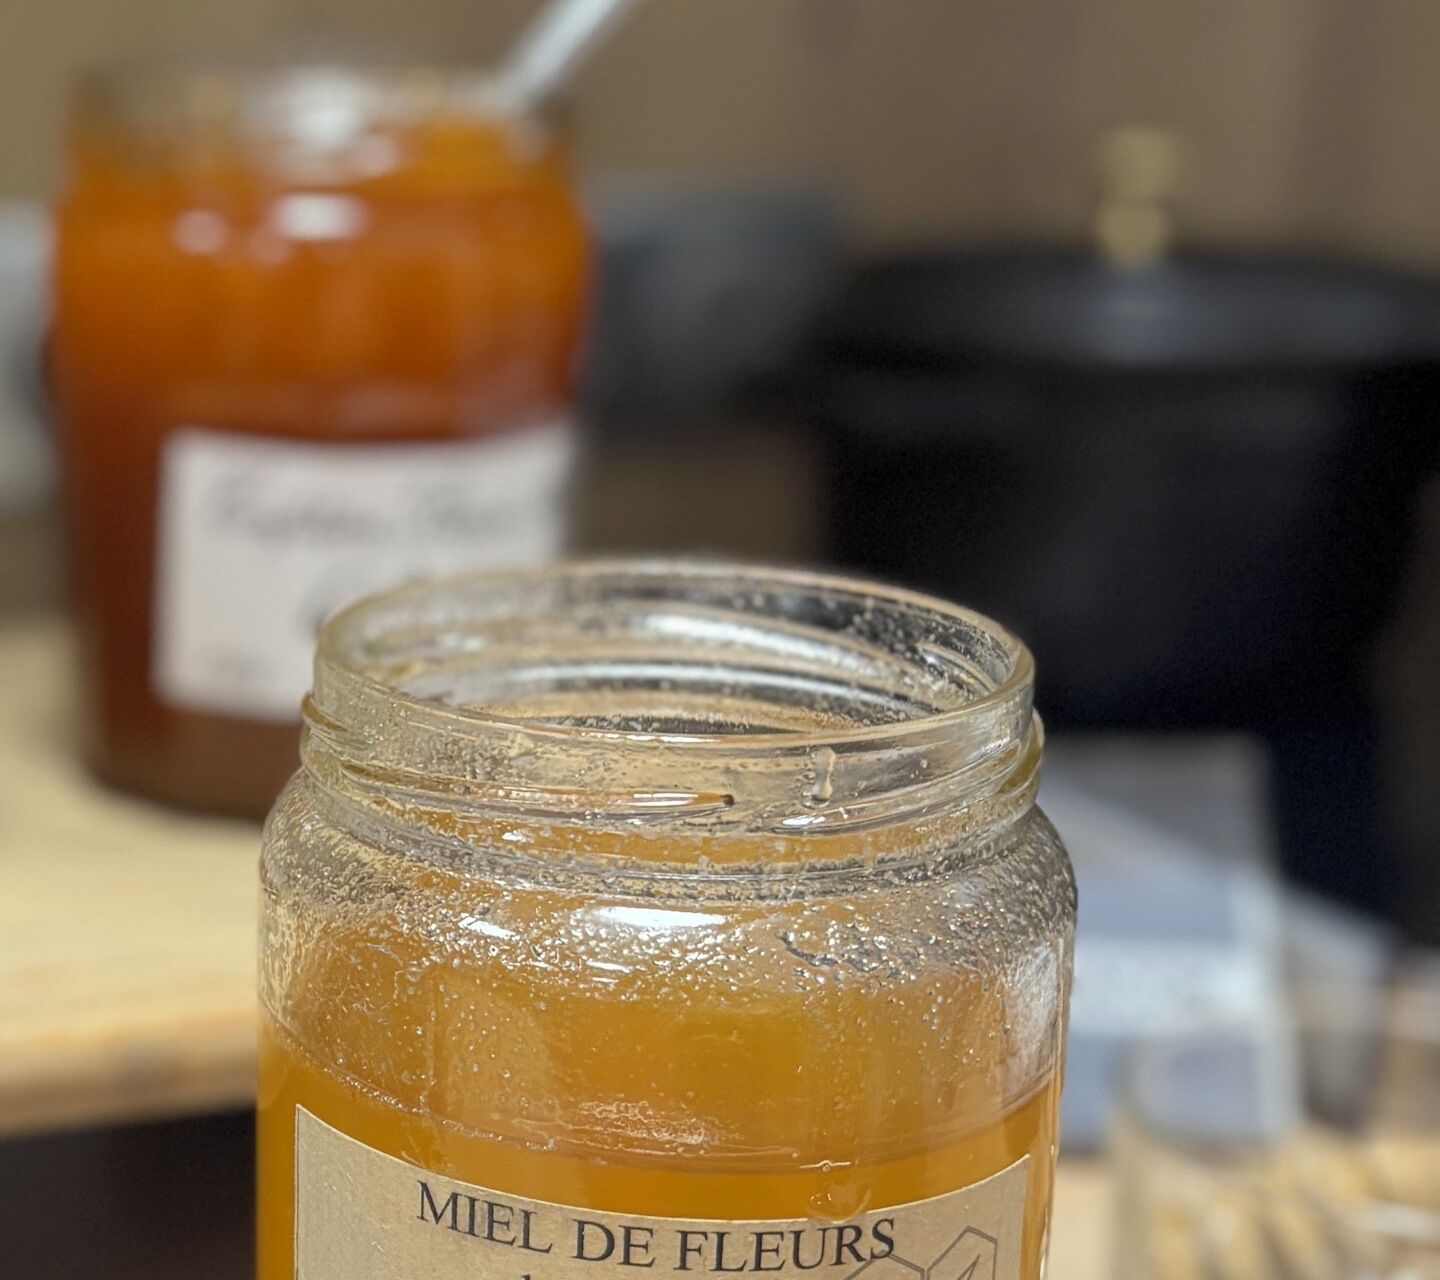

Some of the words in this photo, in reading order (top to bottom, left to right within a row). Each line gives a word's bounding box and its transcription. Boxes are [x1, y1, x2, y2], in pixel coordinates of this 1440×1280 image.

[416, 1180, 553, 1254] MIEL
[571, 1218, 656, 1269] DE
[673, 1218, 895, 1272] FLEURS
